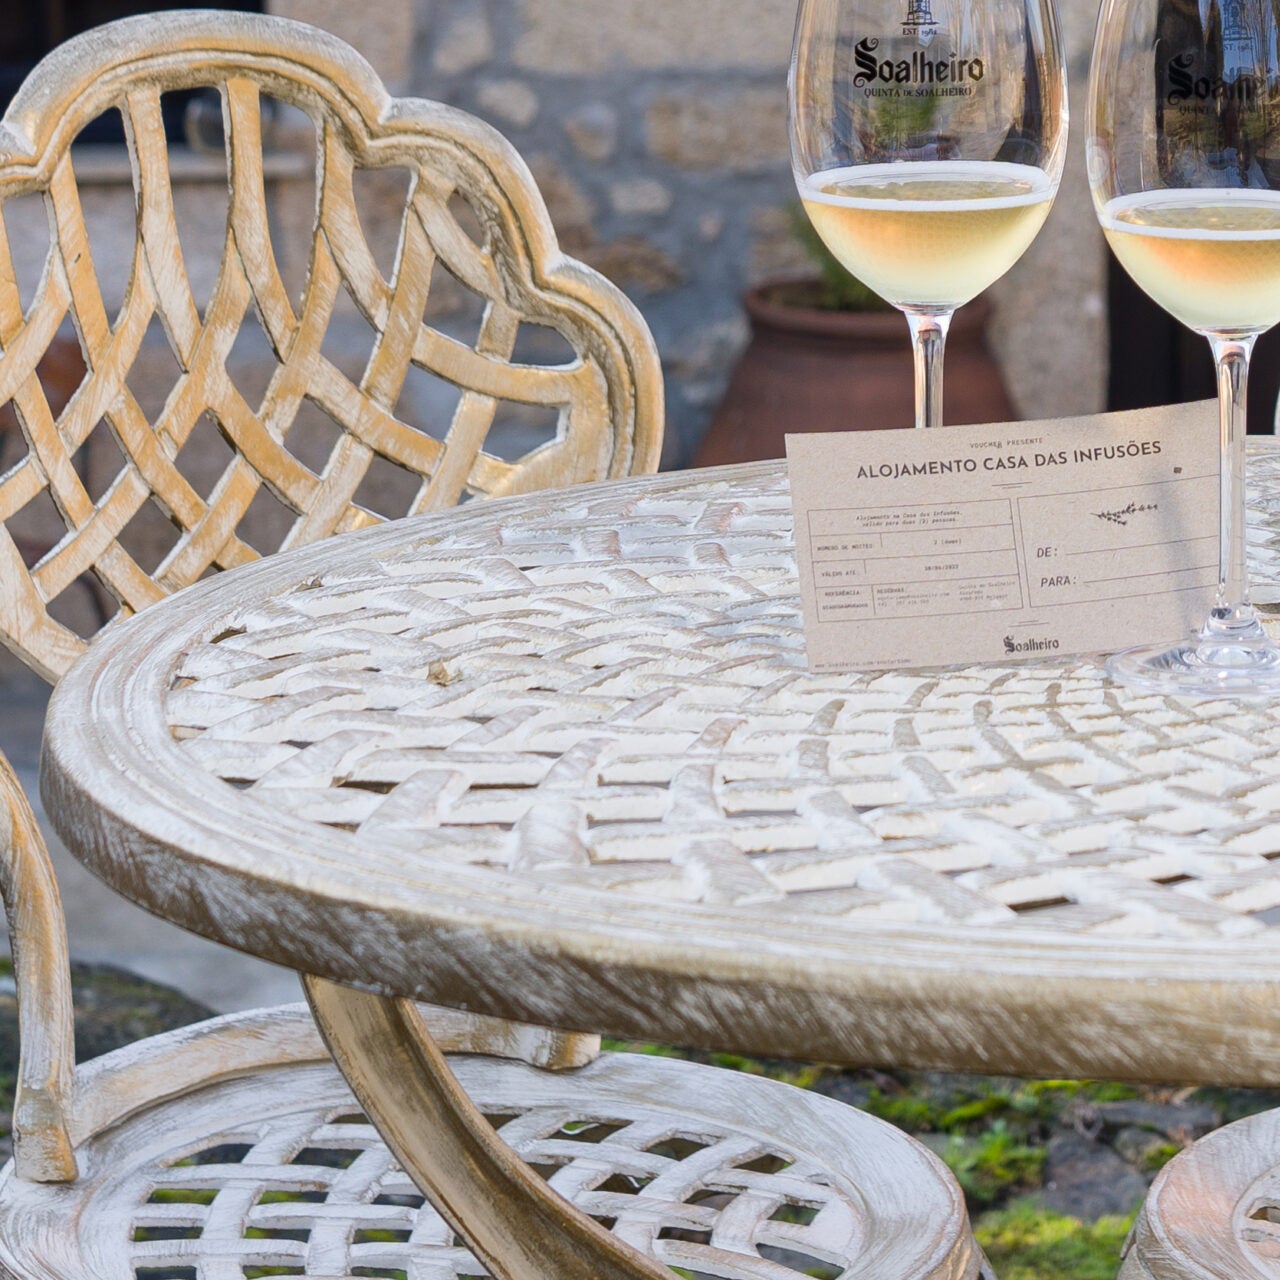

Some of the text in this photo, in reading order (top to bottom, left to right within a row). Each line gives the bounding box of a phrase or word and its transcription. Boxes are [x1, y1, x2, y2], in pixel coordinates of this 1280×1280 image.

[853, 37, 984, 88] Soalheiro
[864, 87, 900, 98] QUINTA
[915, 87, 972, 98] SOALHEIRO
[970, 437, 1043, 449] VOUCHER PRESENTE
[857, 440, 1162, 479] ALOJAMENTO CASA DAS INFUSÕES
[1036, 546, 1058, 558] DE:
[1040, 575, 1076, 588] PARA:
[1003, 635, 1060, 655] Soalheiro
